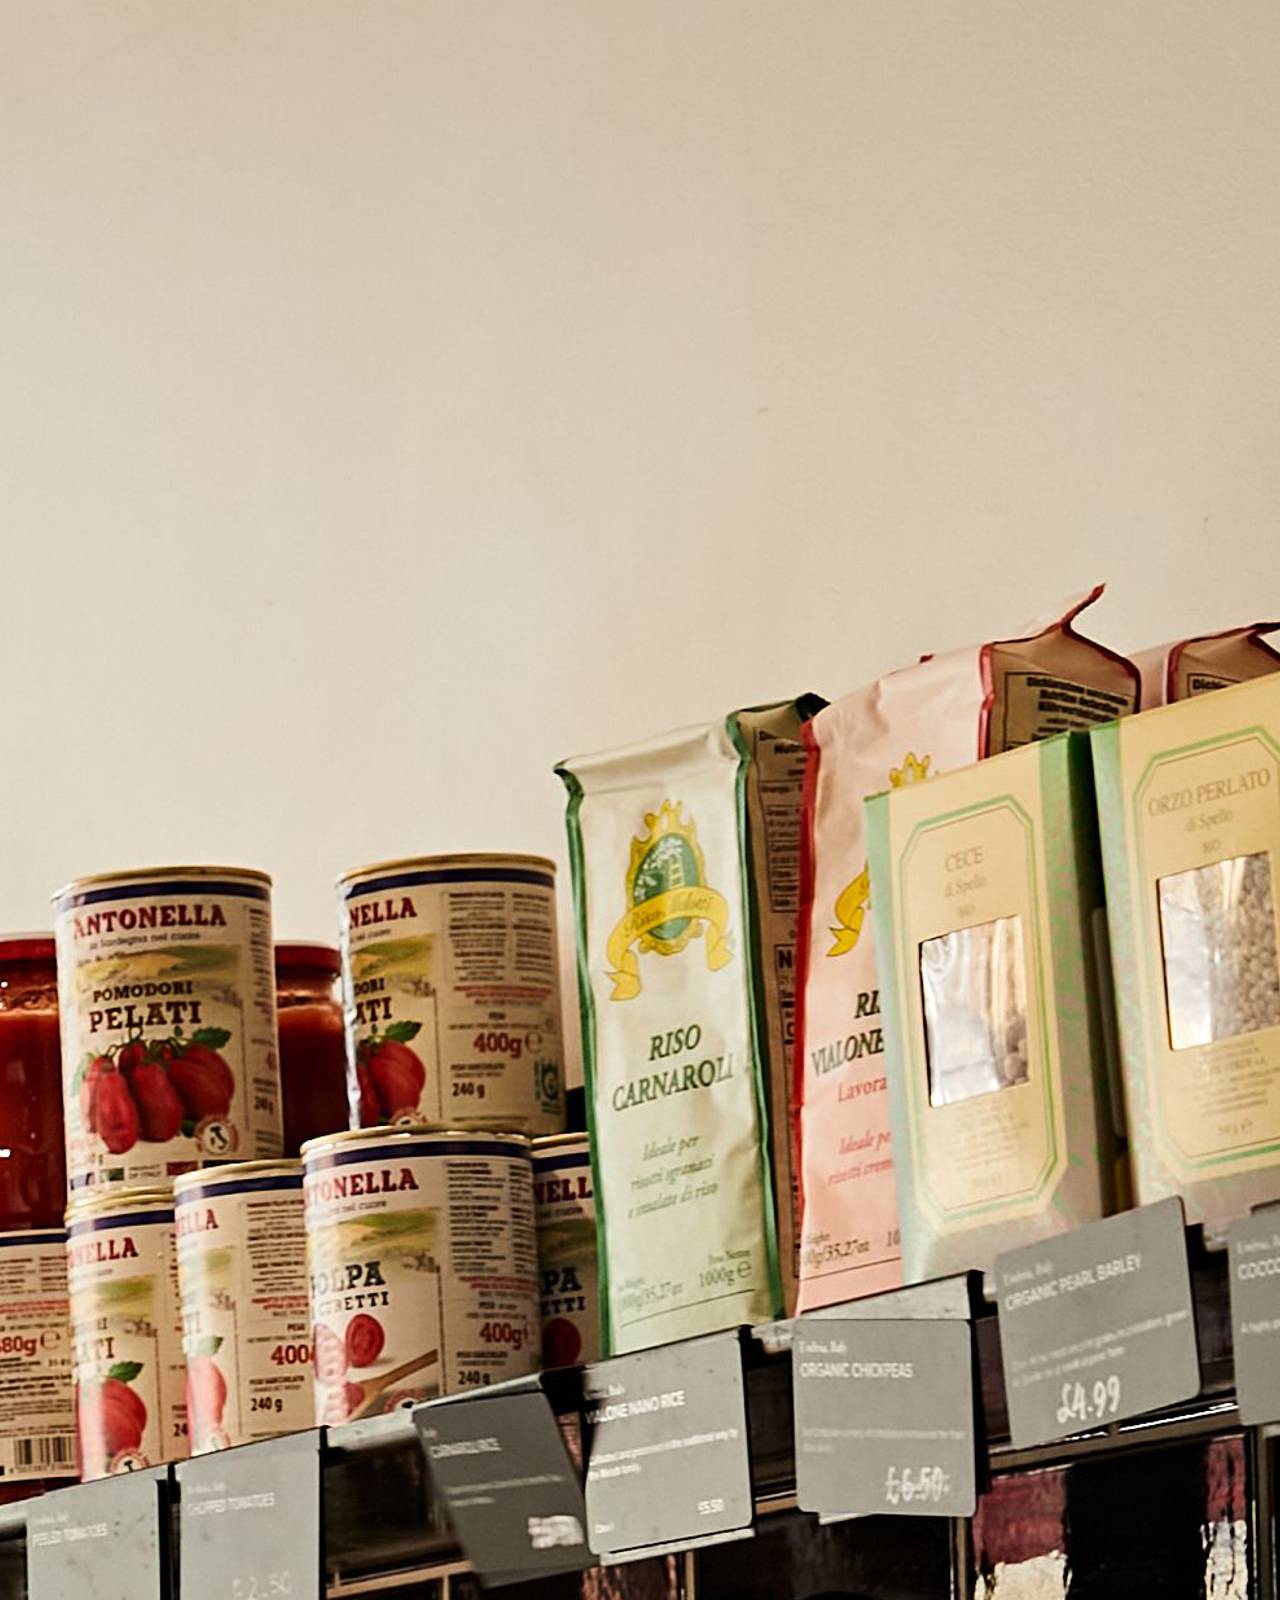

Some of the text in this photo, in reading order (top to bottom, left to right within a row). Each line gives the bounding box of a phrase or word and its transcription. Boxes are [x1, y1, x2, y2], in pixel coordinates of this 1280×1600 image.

[1147, 767, 1271, 817] ORZO PERLATO
[945, 844, 984, 872] CECE
[71, 903, 228, 941] ANTONELLA
[92, 980, 193, 1004] POMODORI
[854, 989, 881, 1019] RI
[89, 1000, 203, 1034] PELATI
[472, 1032, 522, 1059] 400g
[647, 1023, 702, 1062] RISO
[452, 1083, 474, 1097] 240
[611, 1052, 734, 1112] CARNAROLI
[1003, 1254, 1142, 1311] ORGANIC PEARL BARLEY
[478, 1322, 522, 1348] 400g
[799, 1362, 914, 1378] ORGANIC CHICKPEAS
[250, 1397, 272, 1412] 240
[660, 1389, 686, 1409] RICE
[1056, 1374, 1121, 1424] £4.99
